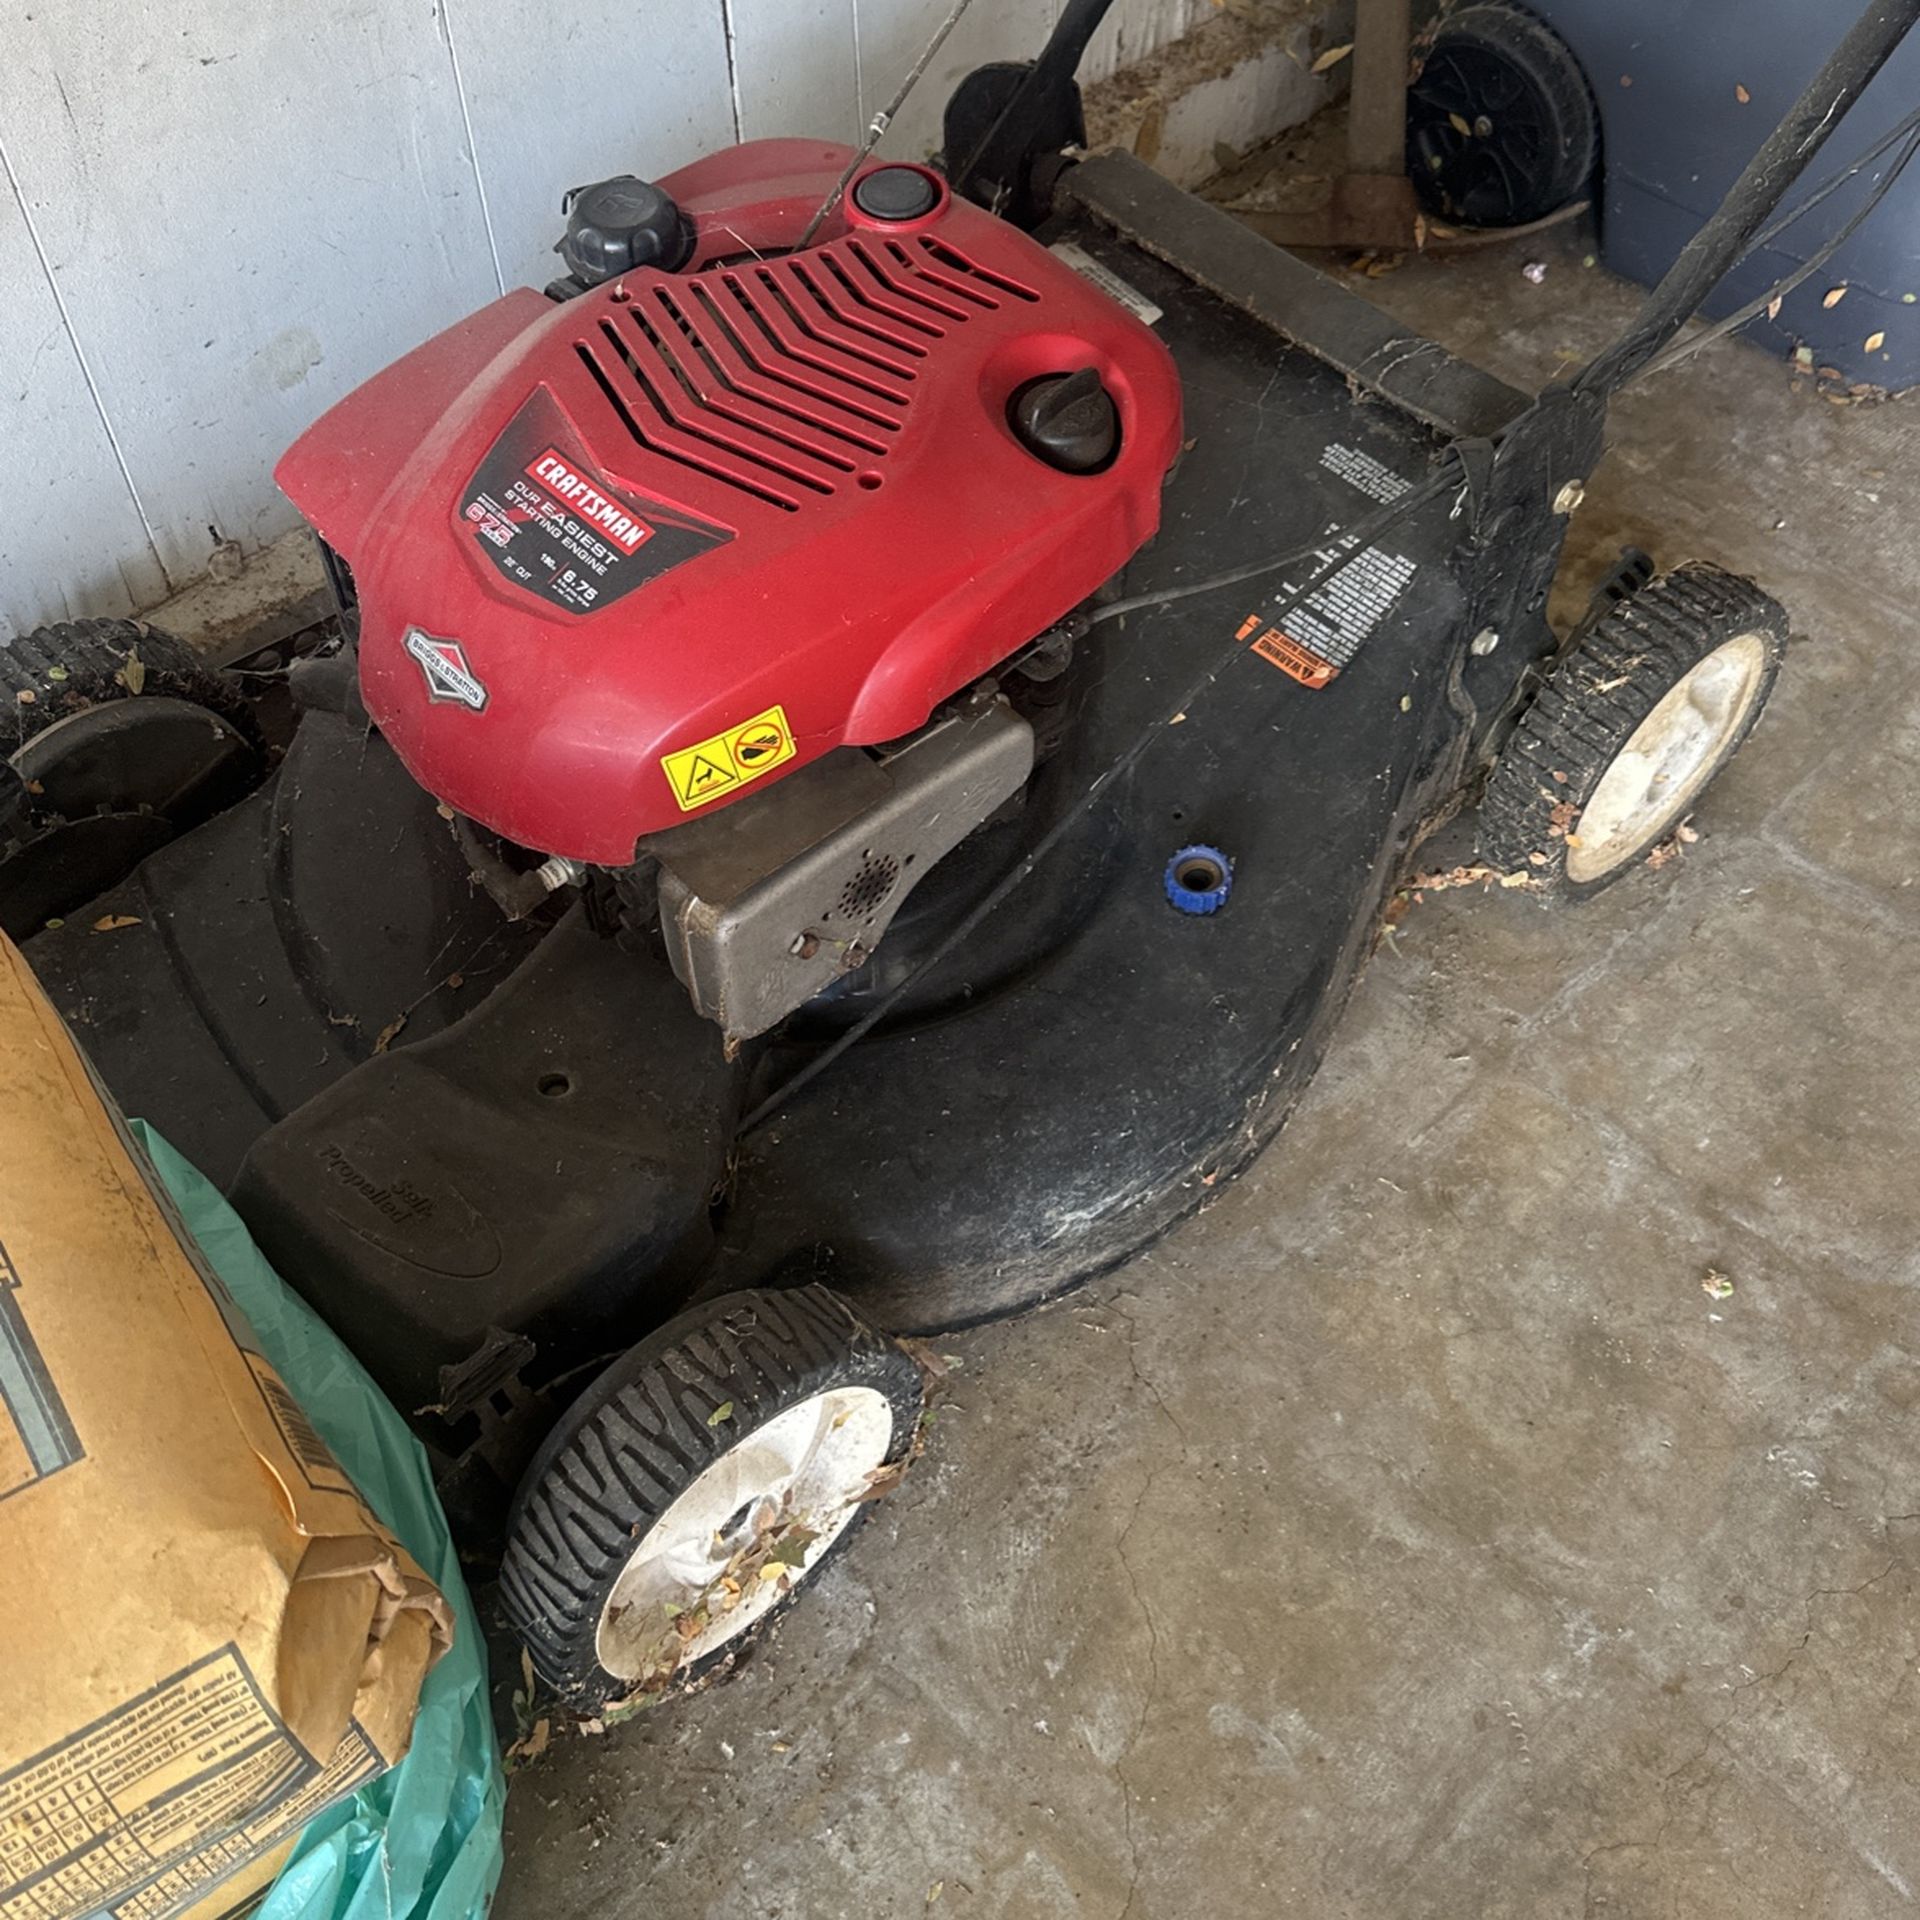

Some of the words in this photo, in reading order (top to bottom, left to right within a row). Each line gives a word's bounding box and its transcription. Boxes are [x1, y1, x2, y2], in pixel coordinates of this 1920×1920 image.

[536, 457, 644, 547] CRAFTSMAN
[466, 502, 515, 545] 675
[513, 481, 540, 506] OUR
[541, 501, 619, 564] EASIEST
[504, 490, 561, 540] STARTING
[562, 536, 607, 576] ENGINE
[516, 566, 532, 581] CUT
[562, 569, 598, 601] 6.75
[1257, 638, 1302, 673] WARNING
[410, 638, 442, 667] BRIGGS
[442, 665, 481, 700] STRATTON
[319, 1147, 412, 1224] Propelled
[224, 1667, 238, 1680] All
[158, 1684, 187, 1706] Based
[186, 1688, 202, 1702] are
[135, 1706, 149, 1719] an
[135, 1694, 189, 1732] approximate
[146, 1699, 160, 1712] on
[179, 1709, 203, 1727] Thick
[84, 1712, 138, 1750] approximate
[120, 1727, 139, 1742] and
[188, 1724, 212, 1743] Thick
[109, 1736, 123, 1749] do
[93, 1743, 111, 1759] not
[54, 1755, 67, 1768] of
[70, 1752, 96, 1772] allow
[57, 1764, 73, 1779] for
[73, 1779, 85, 1791] 2
[47, 1795, 59, 1807] 4
[57, 1810, 68, 1821] 3
[87, 1804, 109, 1823] (0.2)
[105, 1803, 151, 1836] SLABS
[61, 1820, 83, 1838] (0.5)
[98, 1816, 110, 1828] 2
[1, 1837, 20, 1853] 13
[73, 1832, 83, 1843] 5
[44, 1847, 60, 1861] 10
[18, 1861, 35, 1875] 25
